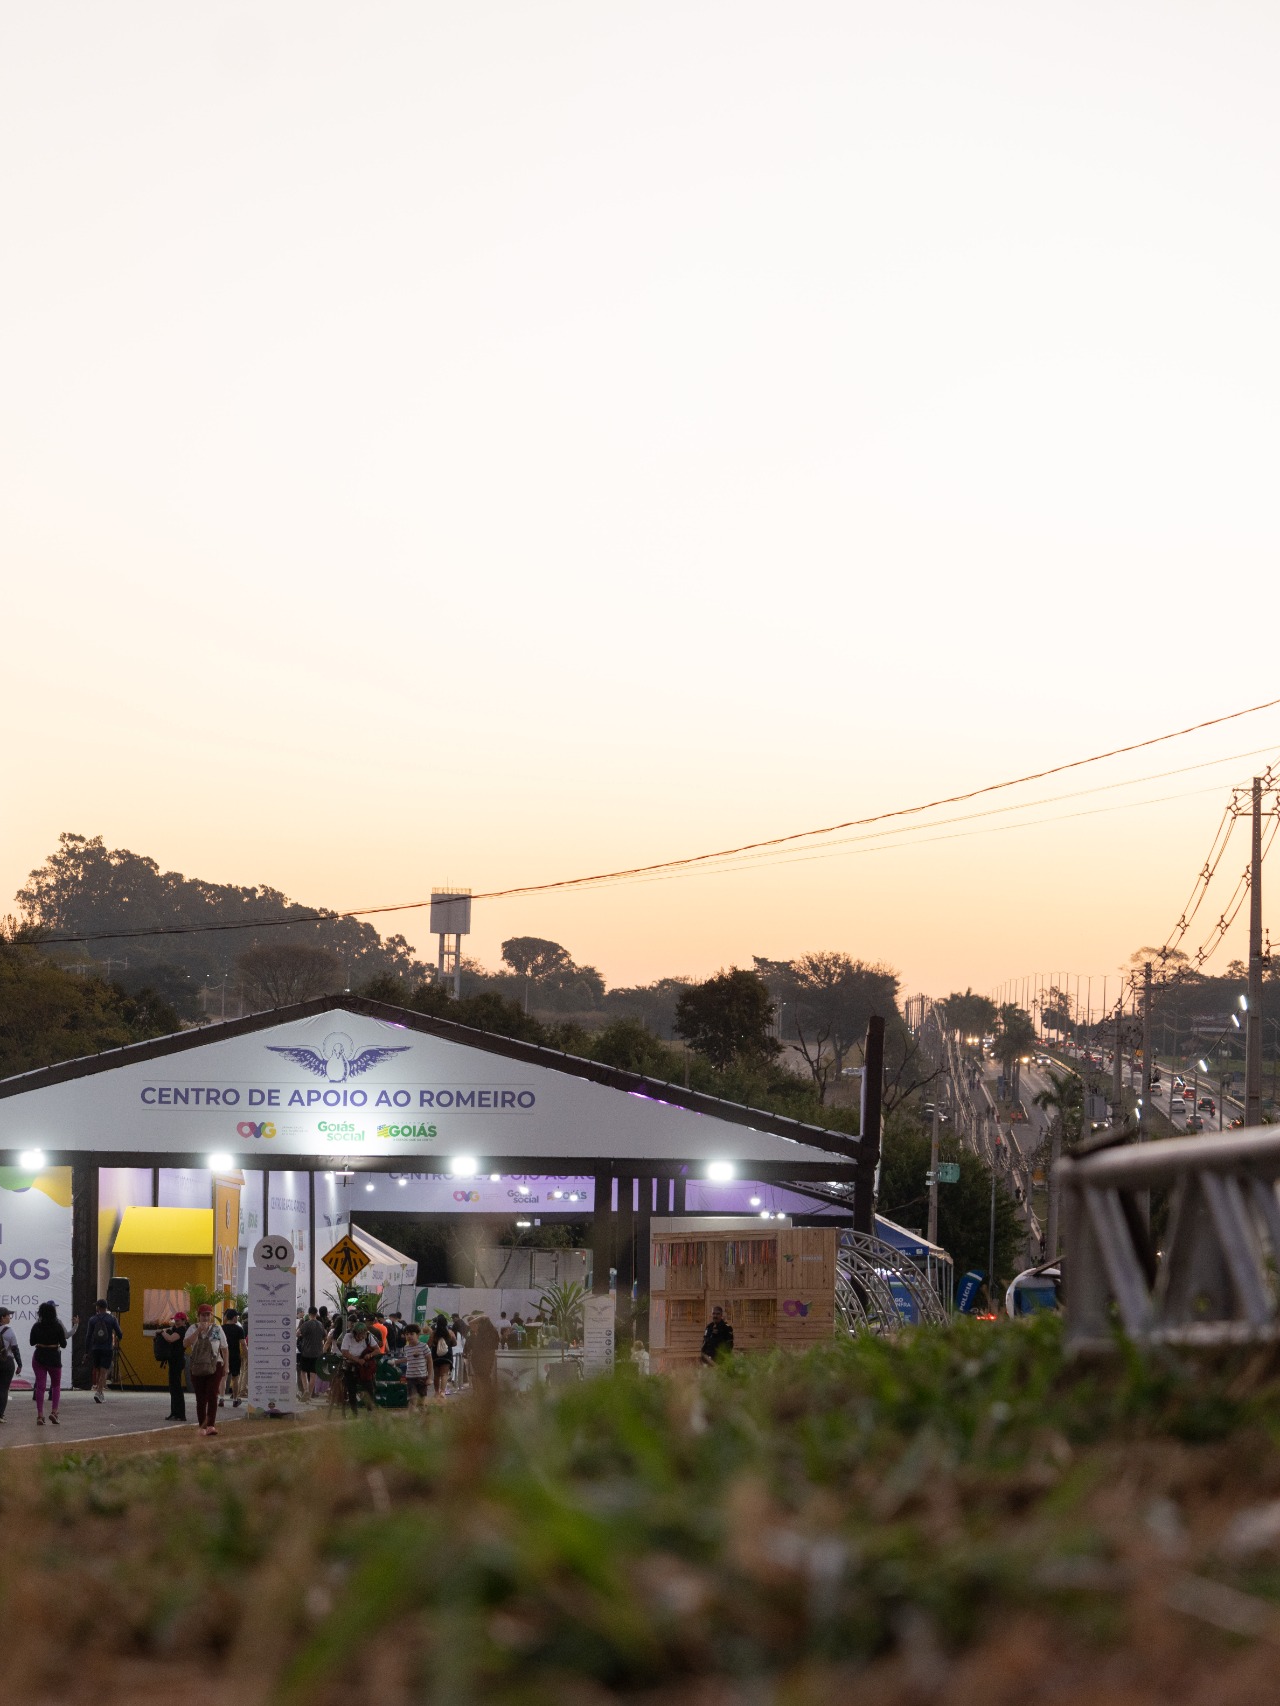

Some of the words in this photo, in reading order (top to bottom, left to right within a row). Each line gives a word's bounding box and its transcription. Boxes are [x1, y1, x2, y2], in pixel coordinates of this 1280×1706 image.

[140, 1086, 240, 1106] CENTRO
[249, 1088, 281, 1107] DE
[287, 1089, 368, 1107] APOIO
[375, 1089, 412, 1108] AO
[419, 1089, 536, 1109] ROMEIRO
[317, 1120, 355, 1132] Goiás
[388, 1123, 438, 1138] GOIÁS
[261, 1244, 287, 1260] 30
